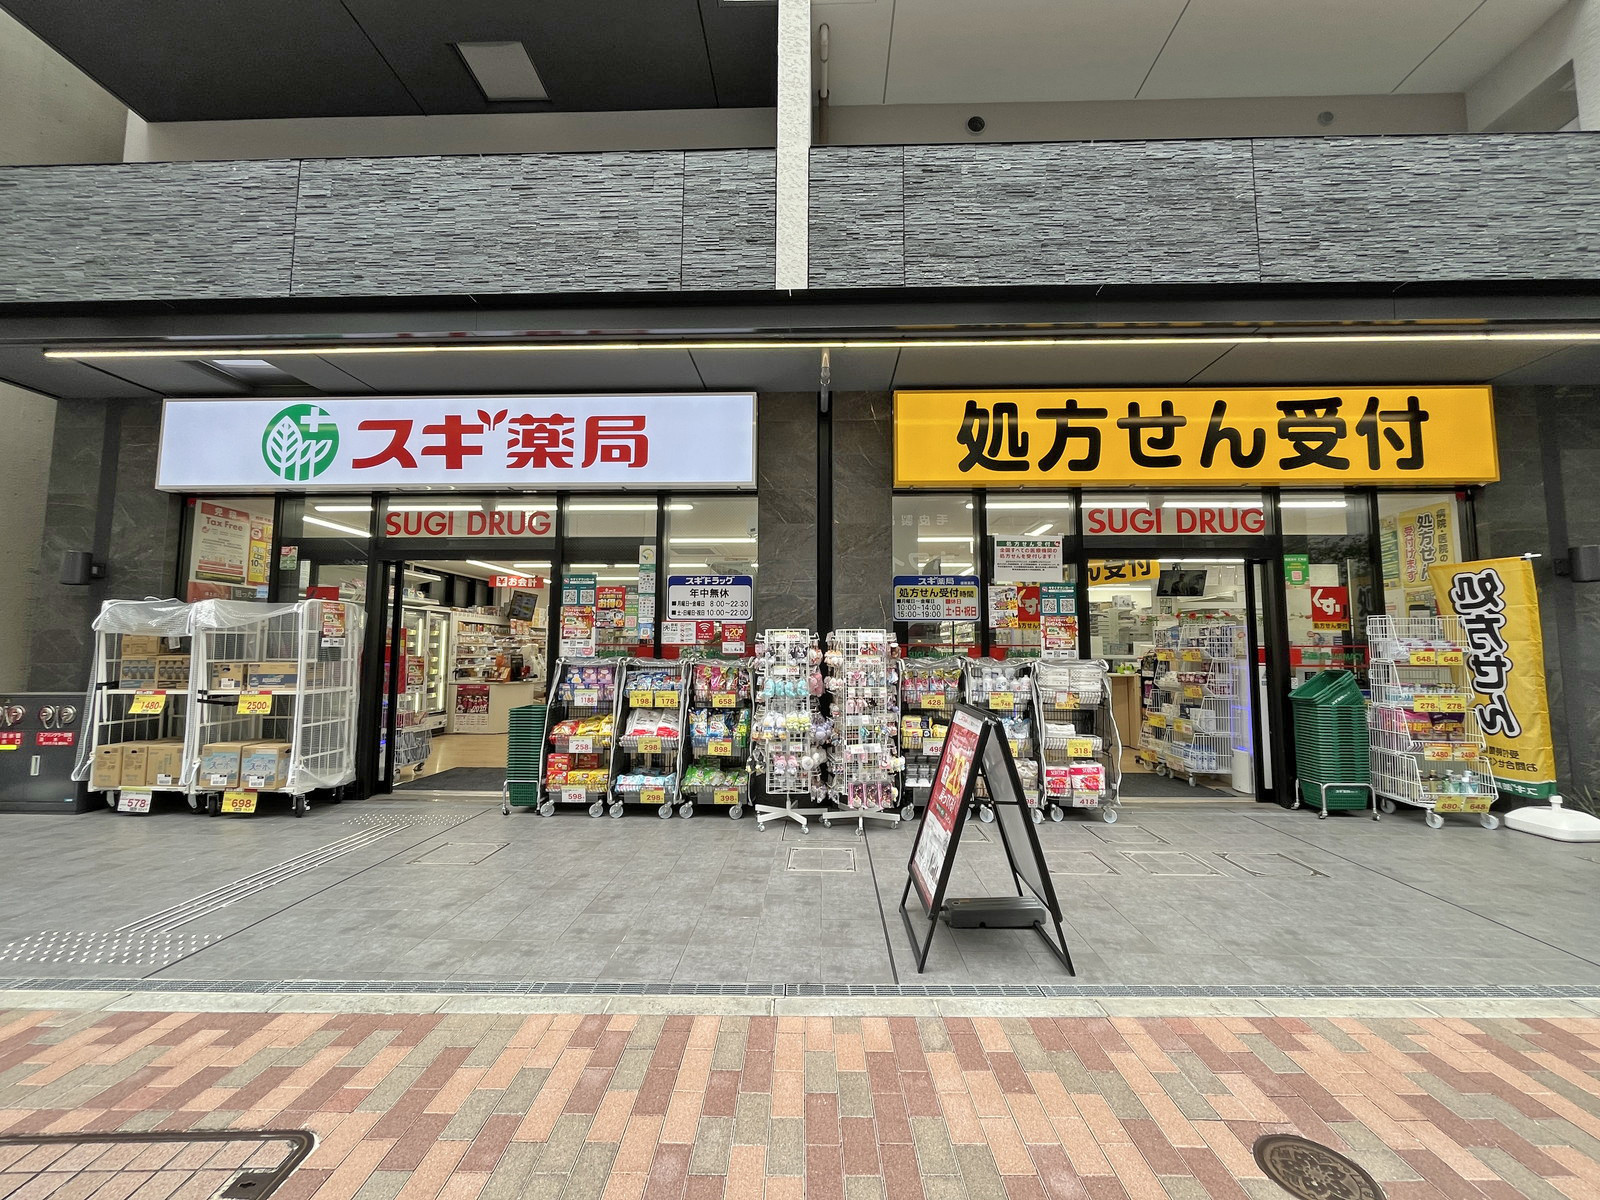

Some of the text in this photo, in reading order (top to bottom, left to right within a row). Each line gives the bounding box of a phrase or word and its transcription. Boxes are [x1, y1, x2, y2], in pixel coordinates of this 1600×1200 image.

[956, 395, 1430, 472] 処方せん受付
[352, 409, 648, 470] スギ薬局
[206, 517, 243, 532] Tax Free
[385, 511, 551, 536] SUGI DRUG
[1088, 508, 1266, 533] SUGI DRUG
[508, 578, 537, 587] お会計
[685, 576, 735, 585] スギドラッグ
[918, 577, 954, 585] スギ薬局
[690, 588, 729, 598] 年中無休
[899, 588, 974, 598] 処方せん受付時間
[127, 799, 146, 808] 578
[231, 799, 252, 808] 698
